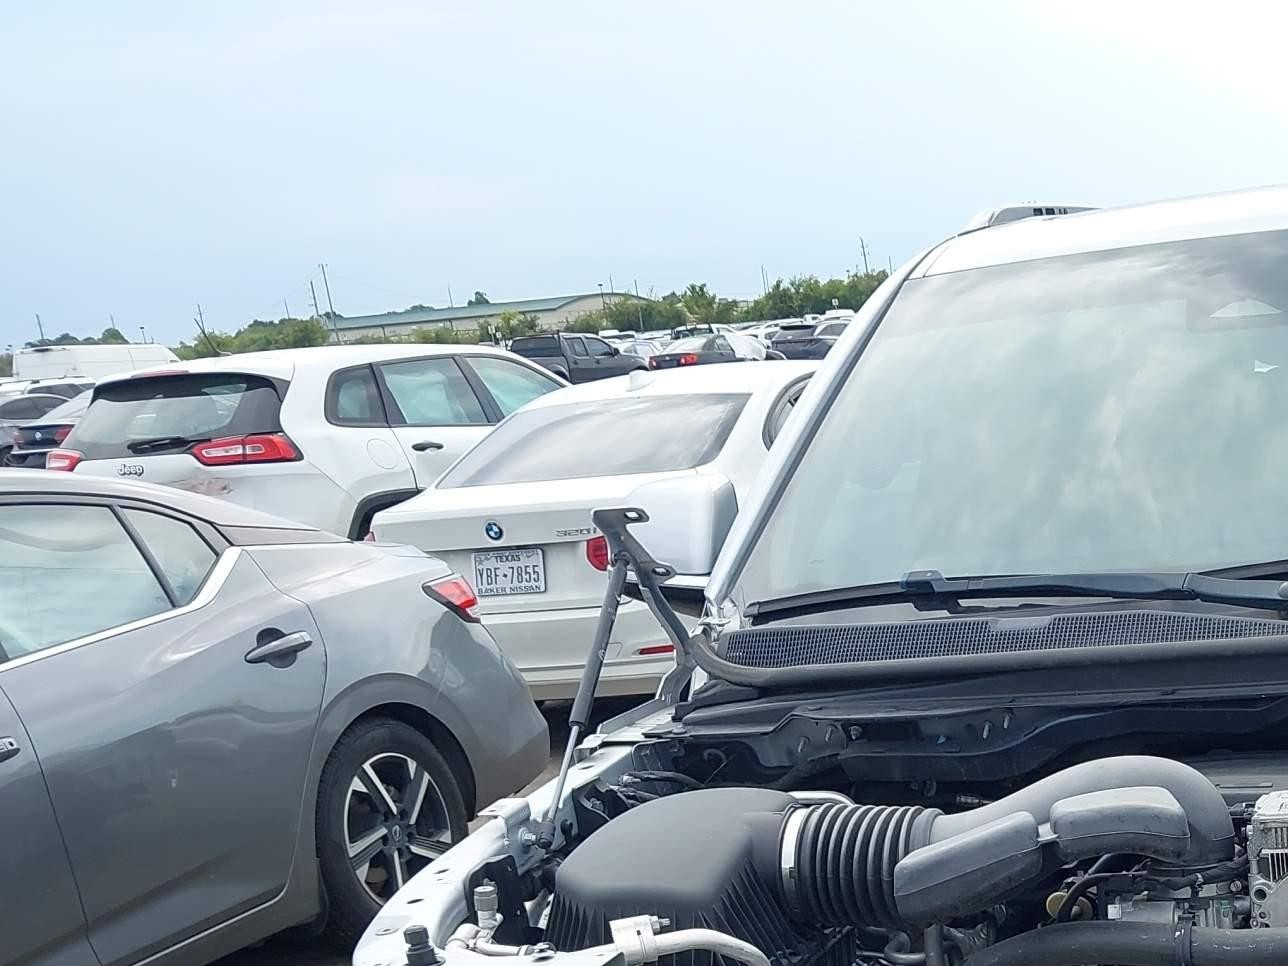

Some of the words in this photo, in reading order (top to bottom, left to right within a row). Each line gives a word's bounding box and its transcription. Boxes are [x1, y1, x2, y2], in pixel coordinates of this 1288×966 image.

[118, 463, 145, 476] Jeep
[495, 554, 521, 564] TEXAS
[477, 586, 506, 595] BAKER
[509, 584, 541, 593] NISSAN
